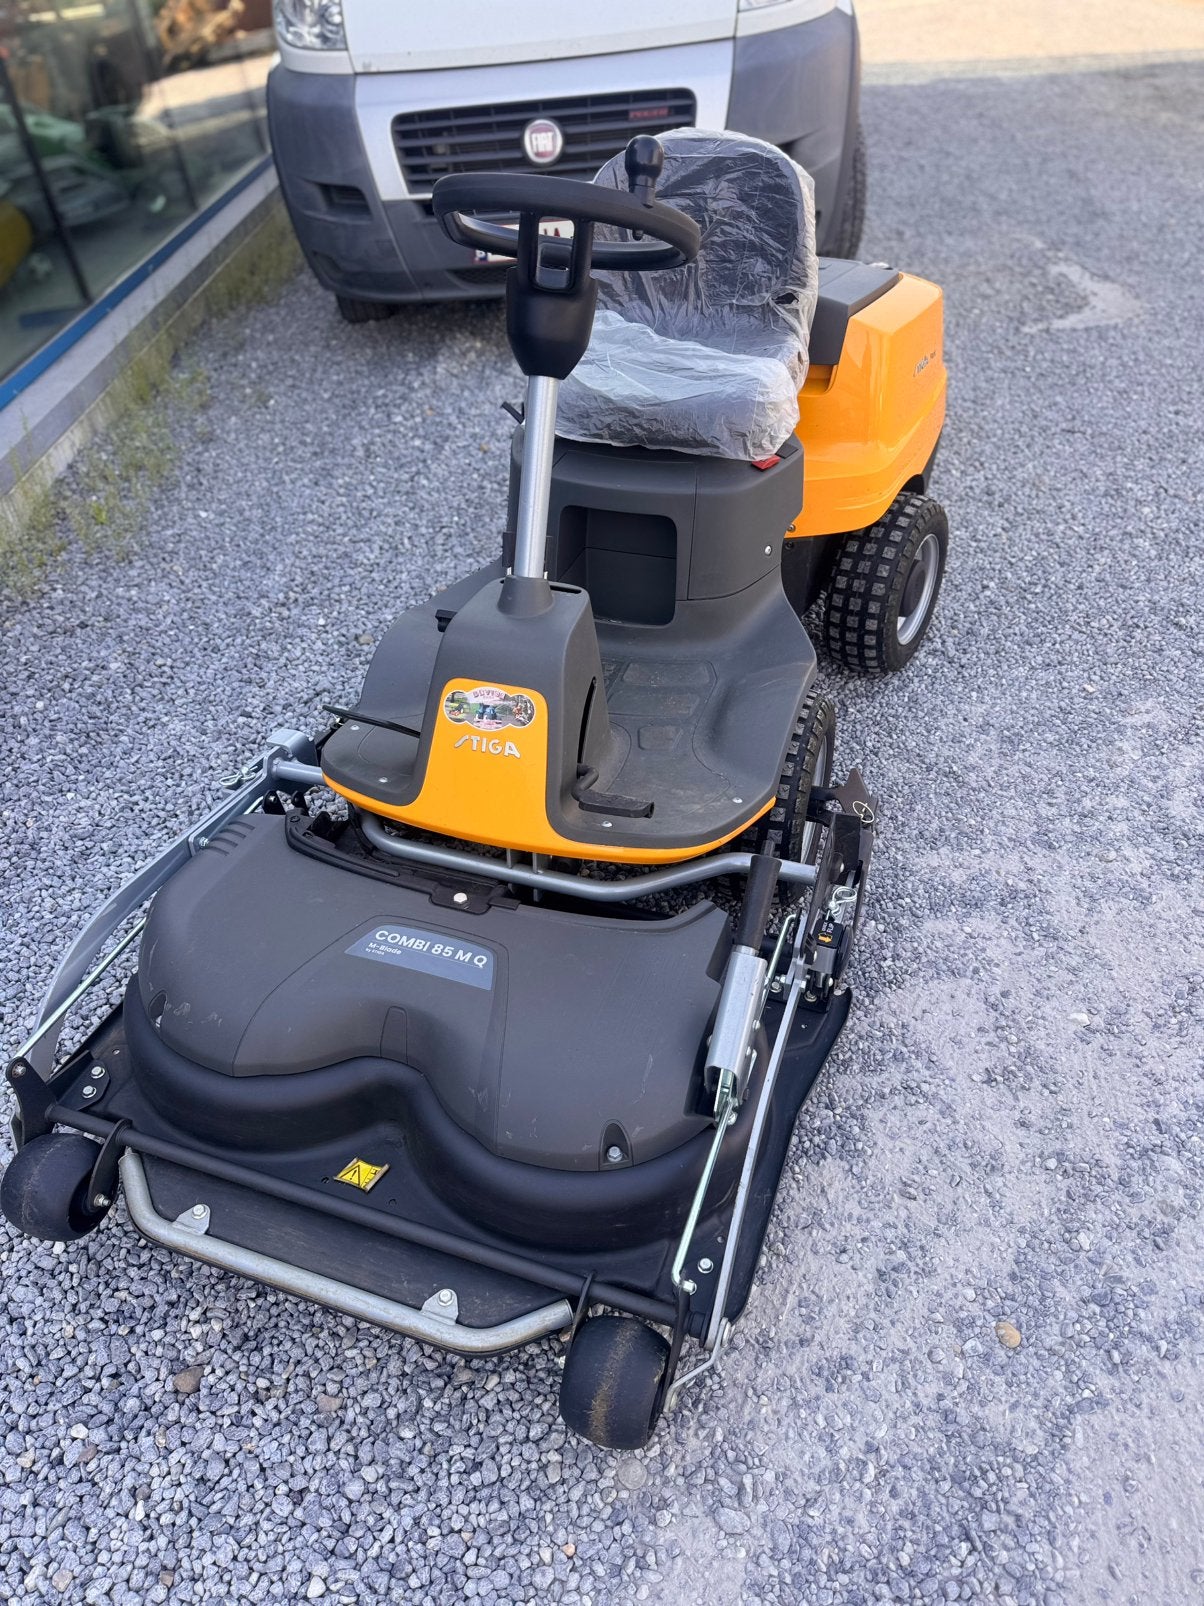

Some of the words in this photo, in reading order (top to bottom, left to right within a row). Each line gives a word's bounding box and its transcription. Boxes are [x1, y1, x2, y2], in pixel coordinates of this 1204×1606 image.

[531, 131, 554, 152] FIAT
[454, 734, 521, 759] STIGA
[368, 941, 402, 956] M-Blade
[375, 930, 431, 952] COMBI
[431, 943, 455, 957] 85
[454, 949, 473, 963] M
[473, 955, 488, 969] Q
